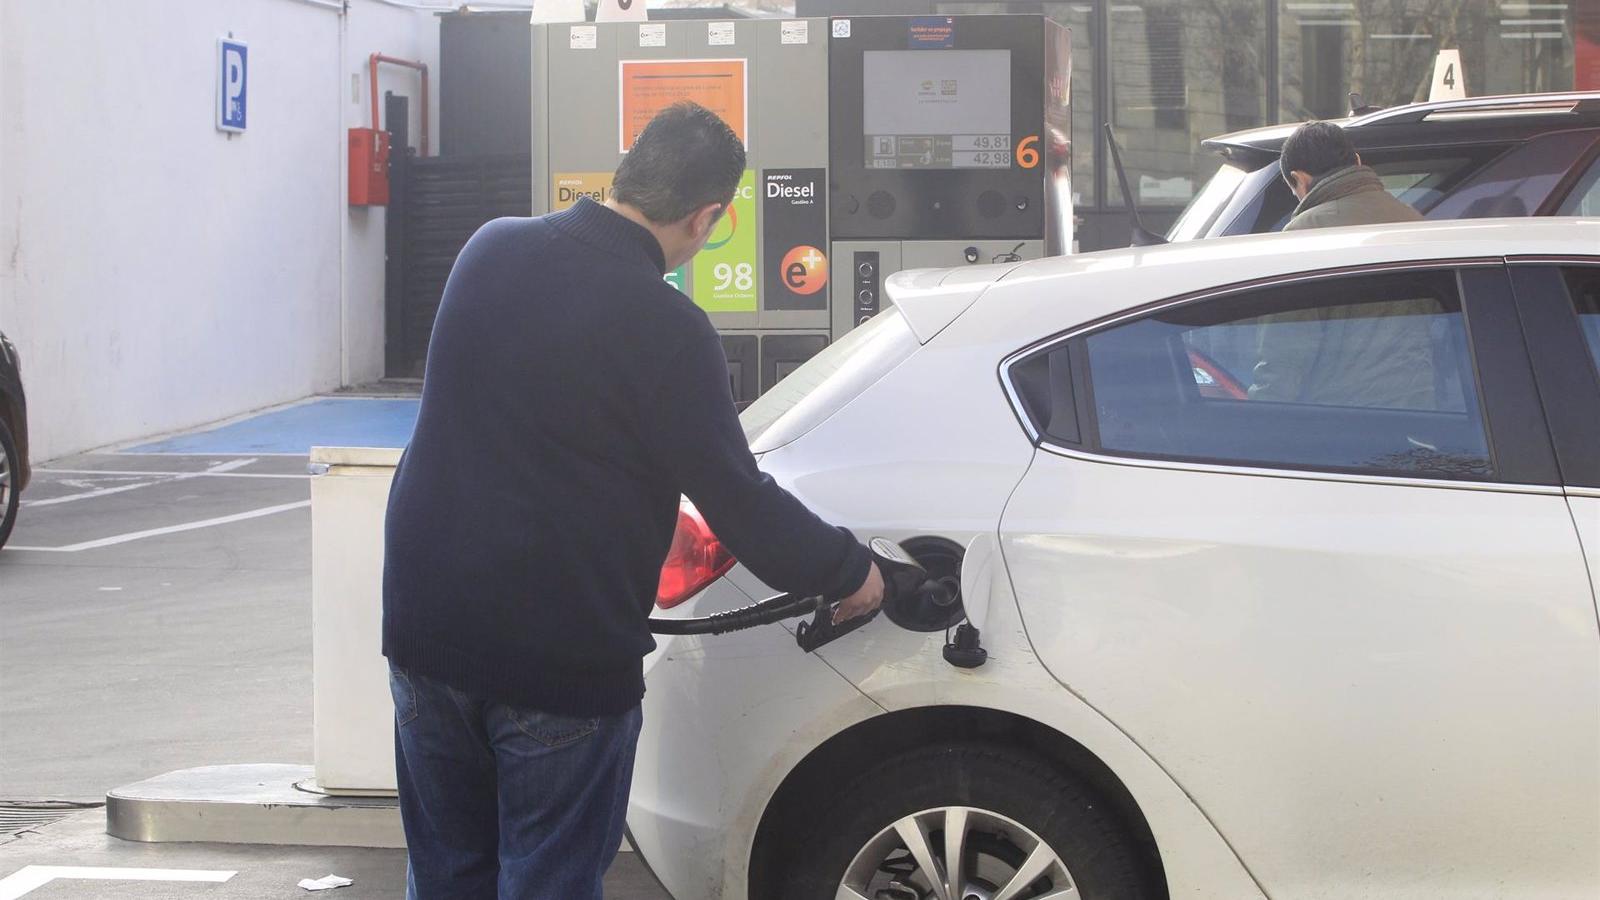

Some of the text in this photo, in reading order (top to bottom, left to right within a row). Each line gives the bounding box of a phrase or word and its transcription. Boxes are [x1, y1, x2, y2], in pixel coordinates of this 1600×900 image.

[226, 49, 244, 121] P
[1443, 63, 1455, 90] 4
[1016, 135, 1039, 169] 6
[767, 182, 814, 198] Diesel
[713, 262, 753, 291] 98
